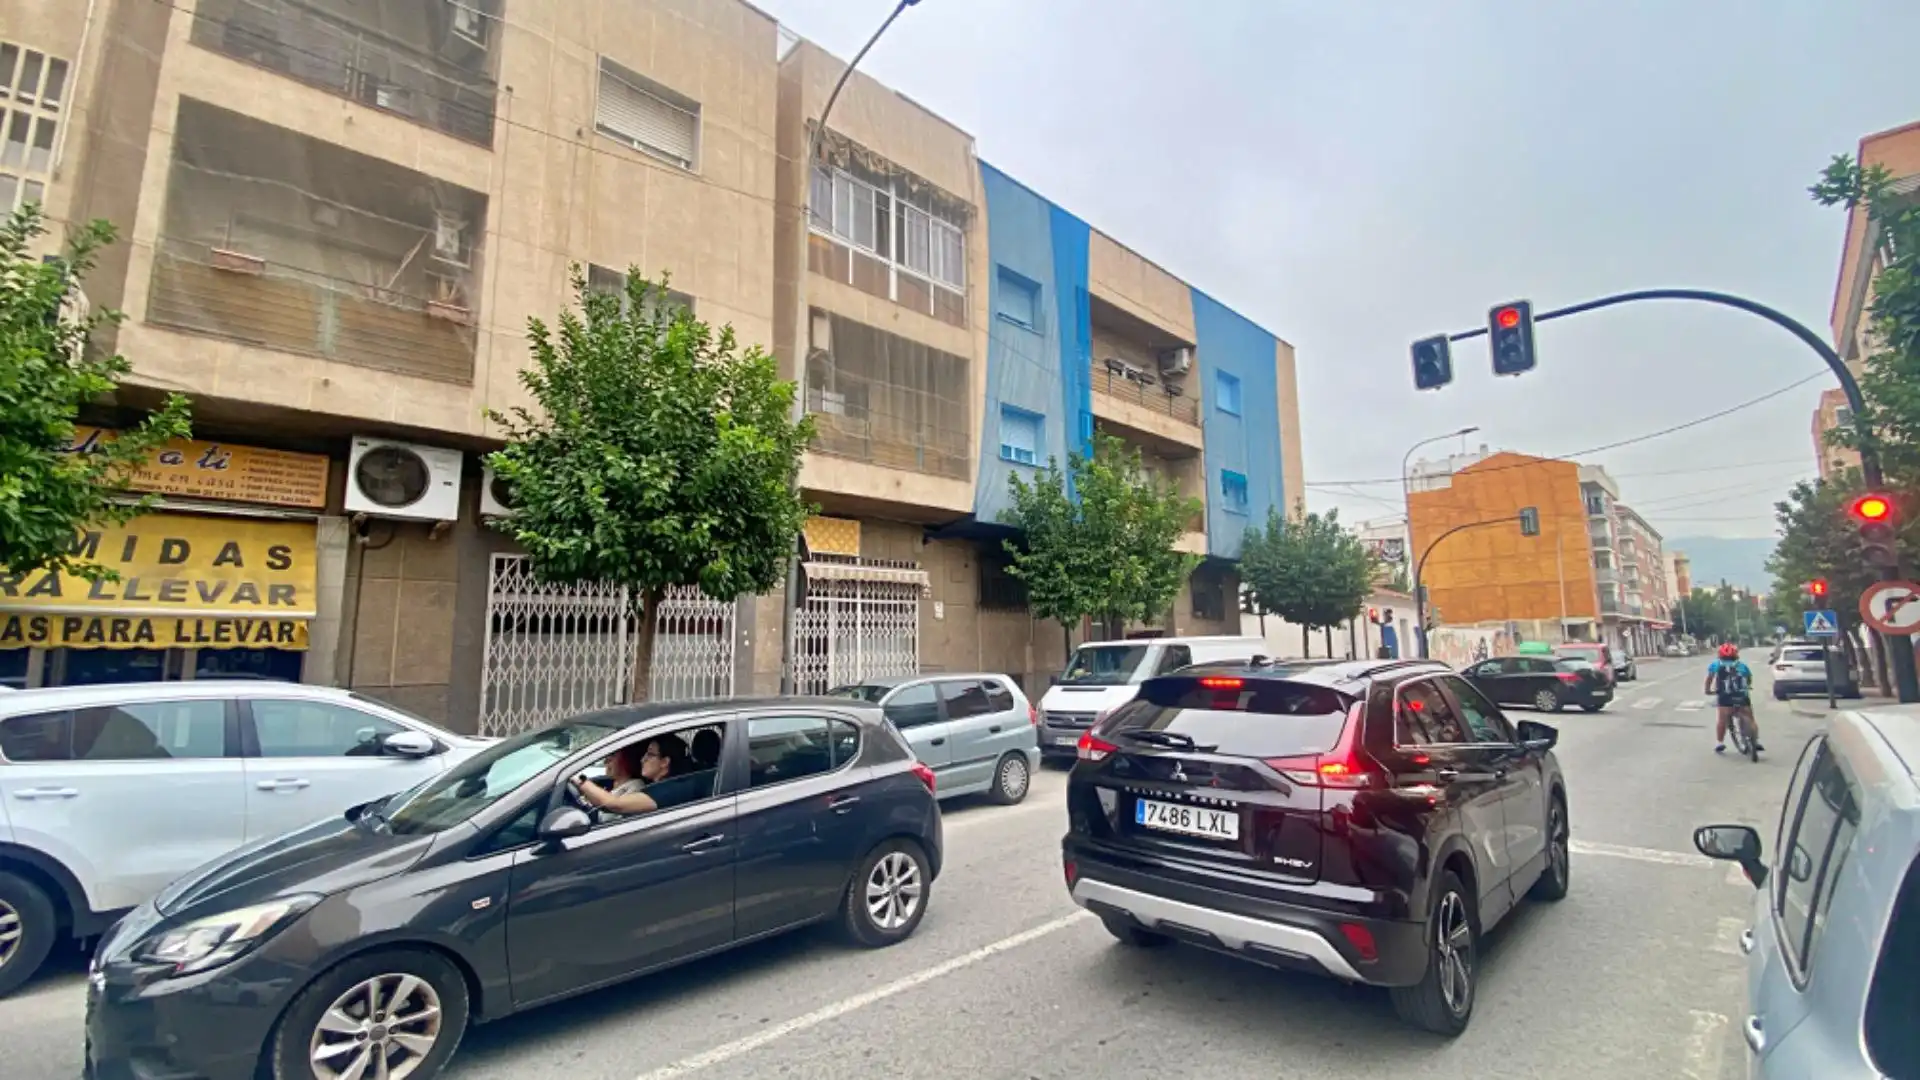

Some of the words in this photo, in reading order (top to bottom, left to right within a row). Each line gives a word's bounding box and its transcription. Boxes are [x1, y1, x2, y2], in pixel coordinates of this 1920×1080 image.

[88, 576, 296, 606] LLEVAR
[1, 615, 49, 642] AS
[62, 616, 155, 643] PARA
[175, 618, 296, 643] LLEVAR
[1148, 803, 1191, 828] 7486
[1197, 811, 1231, 835] LXL
